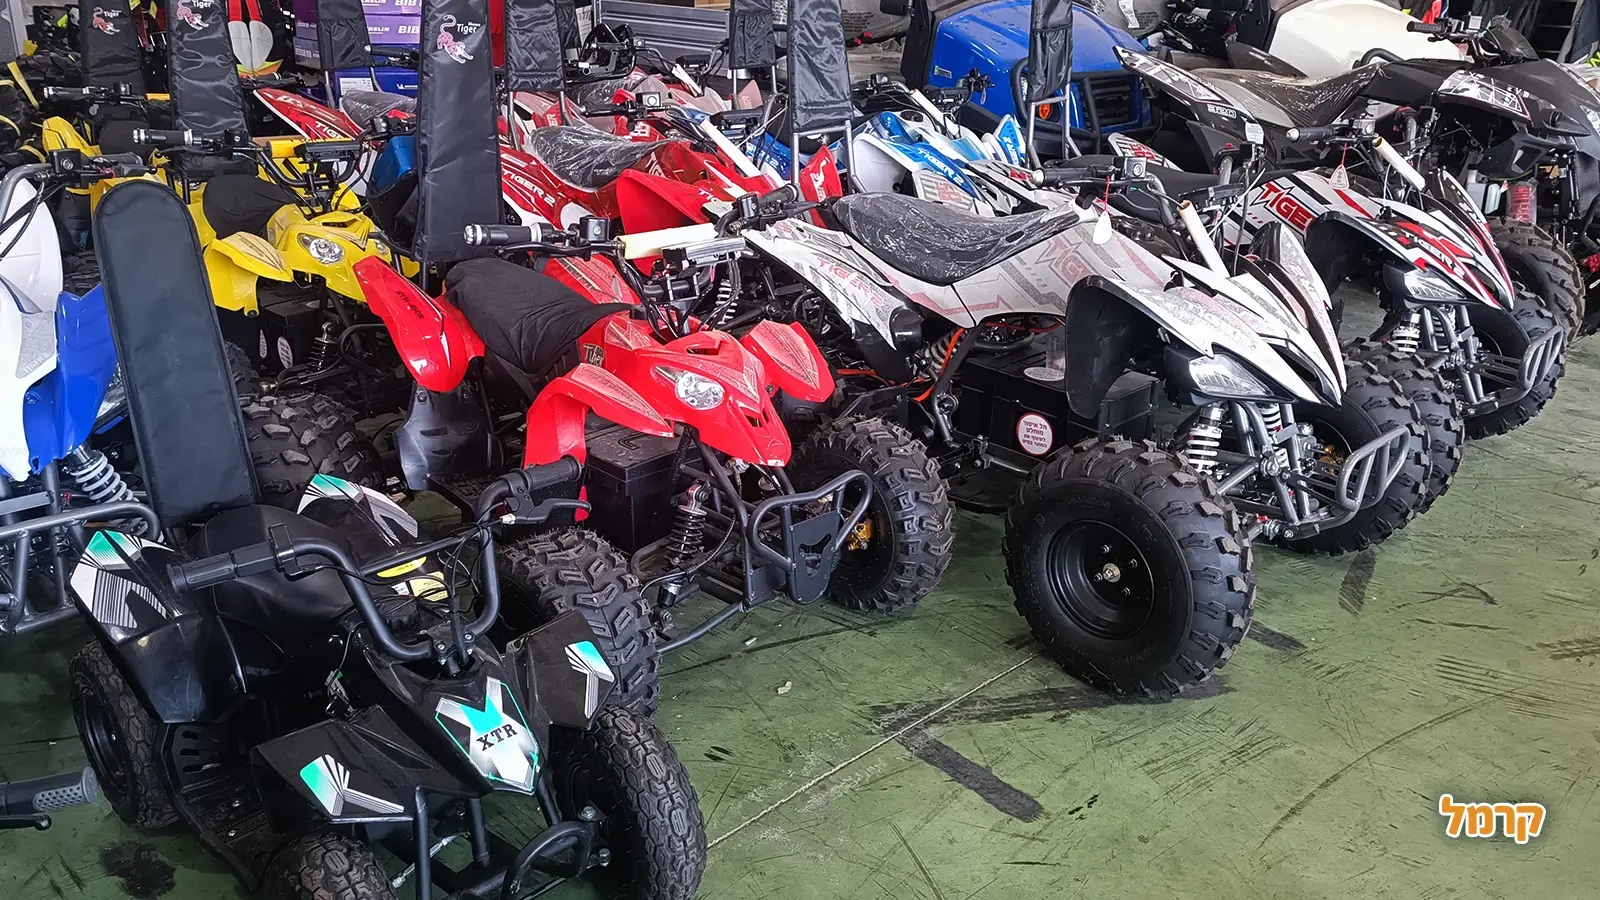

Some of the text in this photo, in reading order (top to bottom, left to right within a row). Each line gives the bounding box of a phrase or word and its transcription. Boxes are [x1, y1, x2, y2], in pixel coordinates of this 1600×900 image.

[456, 23, 477, 35] Tiger
[917, 148, 956, 178] TIGER
[501, 169, 557, 207] TIGER 2
[1259, 181, 1318, 233] TIGE
[818, 259, 870, 298] TIGER
[475, 723, 518, 752] XTR
